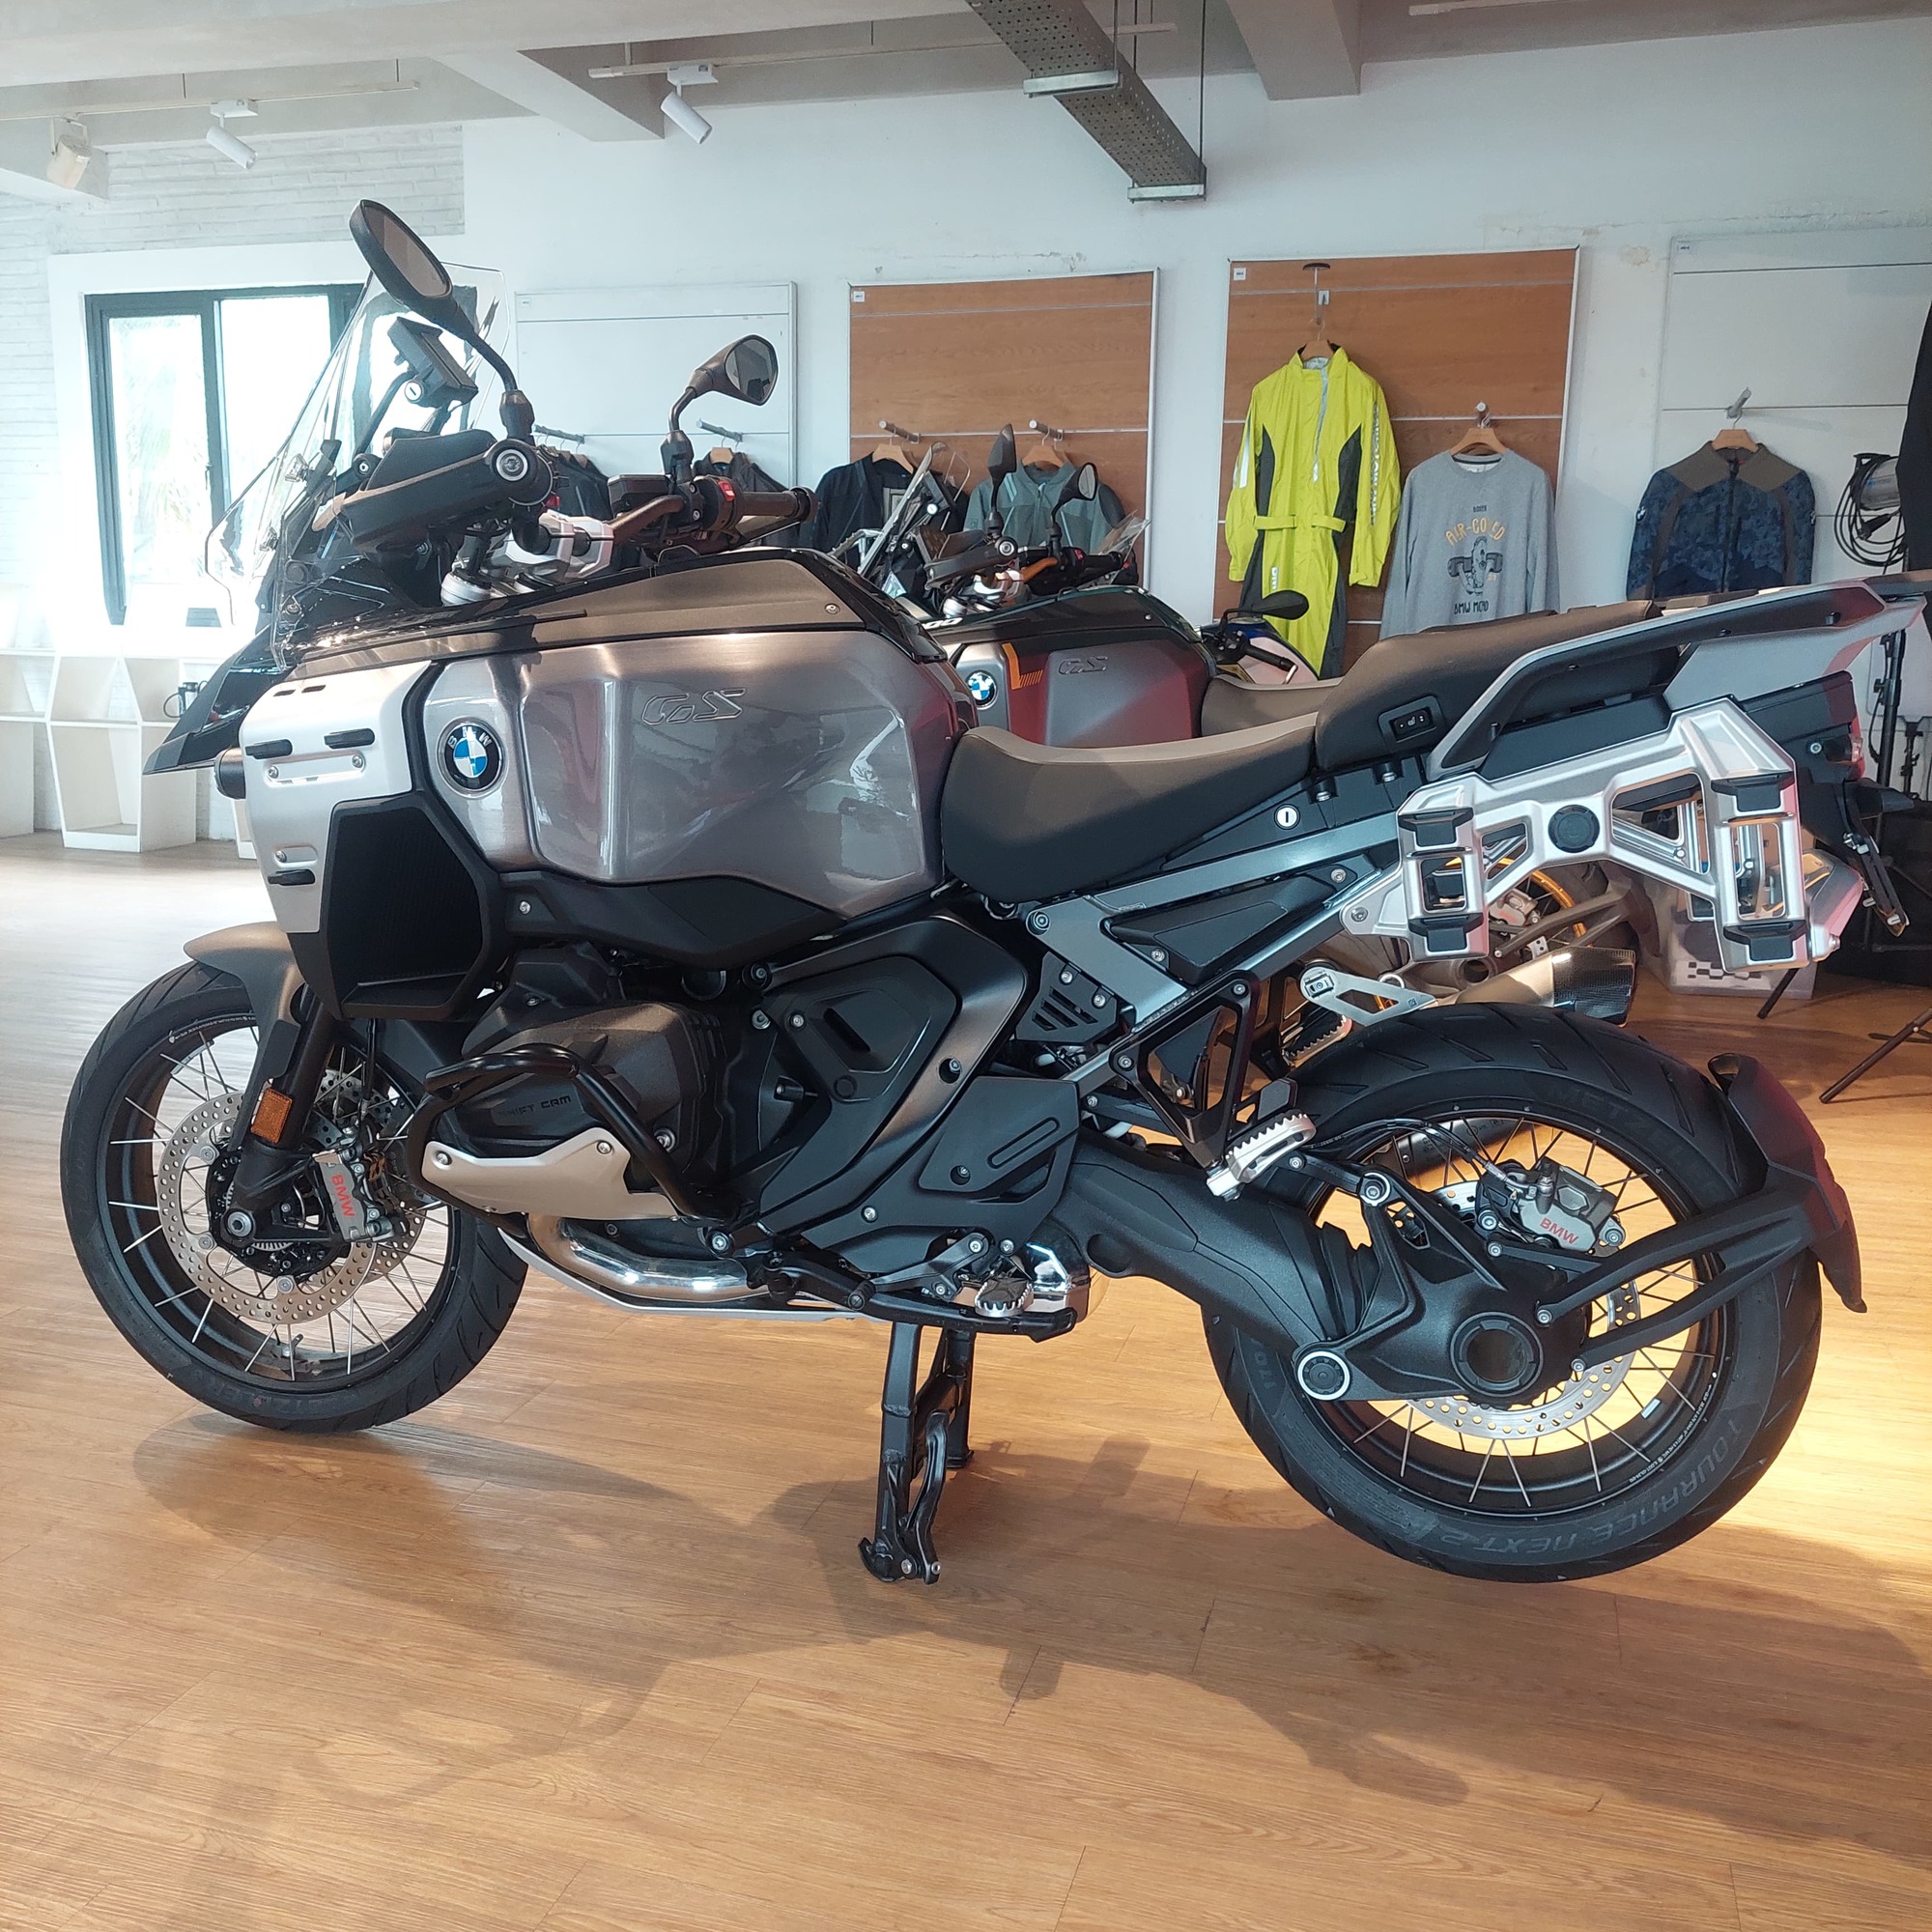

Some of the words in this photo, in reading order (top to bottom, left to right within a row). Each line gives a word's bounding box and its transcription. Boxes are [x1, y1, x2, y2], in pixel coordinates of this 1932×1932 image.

[1445, 517, 1505, 547] AIR-COED
[1454, 601, 1471, 615] BMW
[922, 617, 963, 630] 00
[641, 688, 747, 725] GS
[447, 725, 493, 750] BMW
[540, 1094, 572, 1110] CAM
[330, 1174, 355, 1217] BMW
[1539, 1217, 1579, 1244] BMW
[1591, 1416, 1743, 1543] TOURANCE
[1473, 1533, 1583, 1553] NEXT
